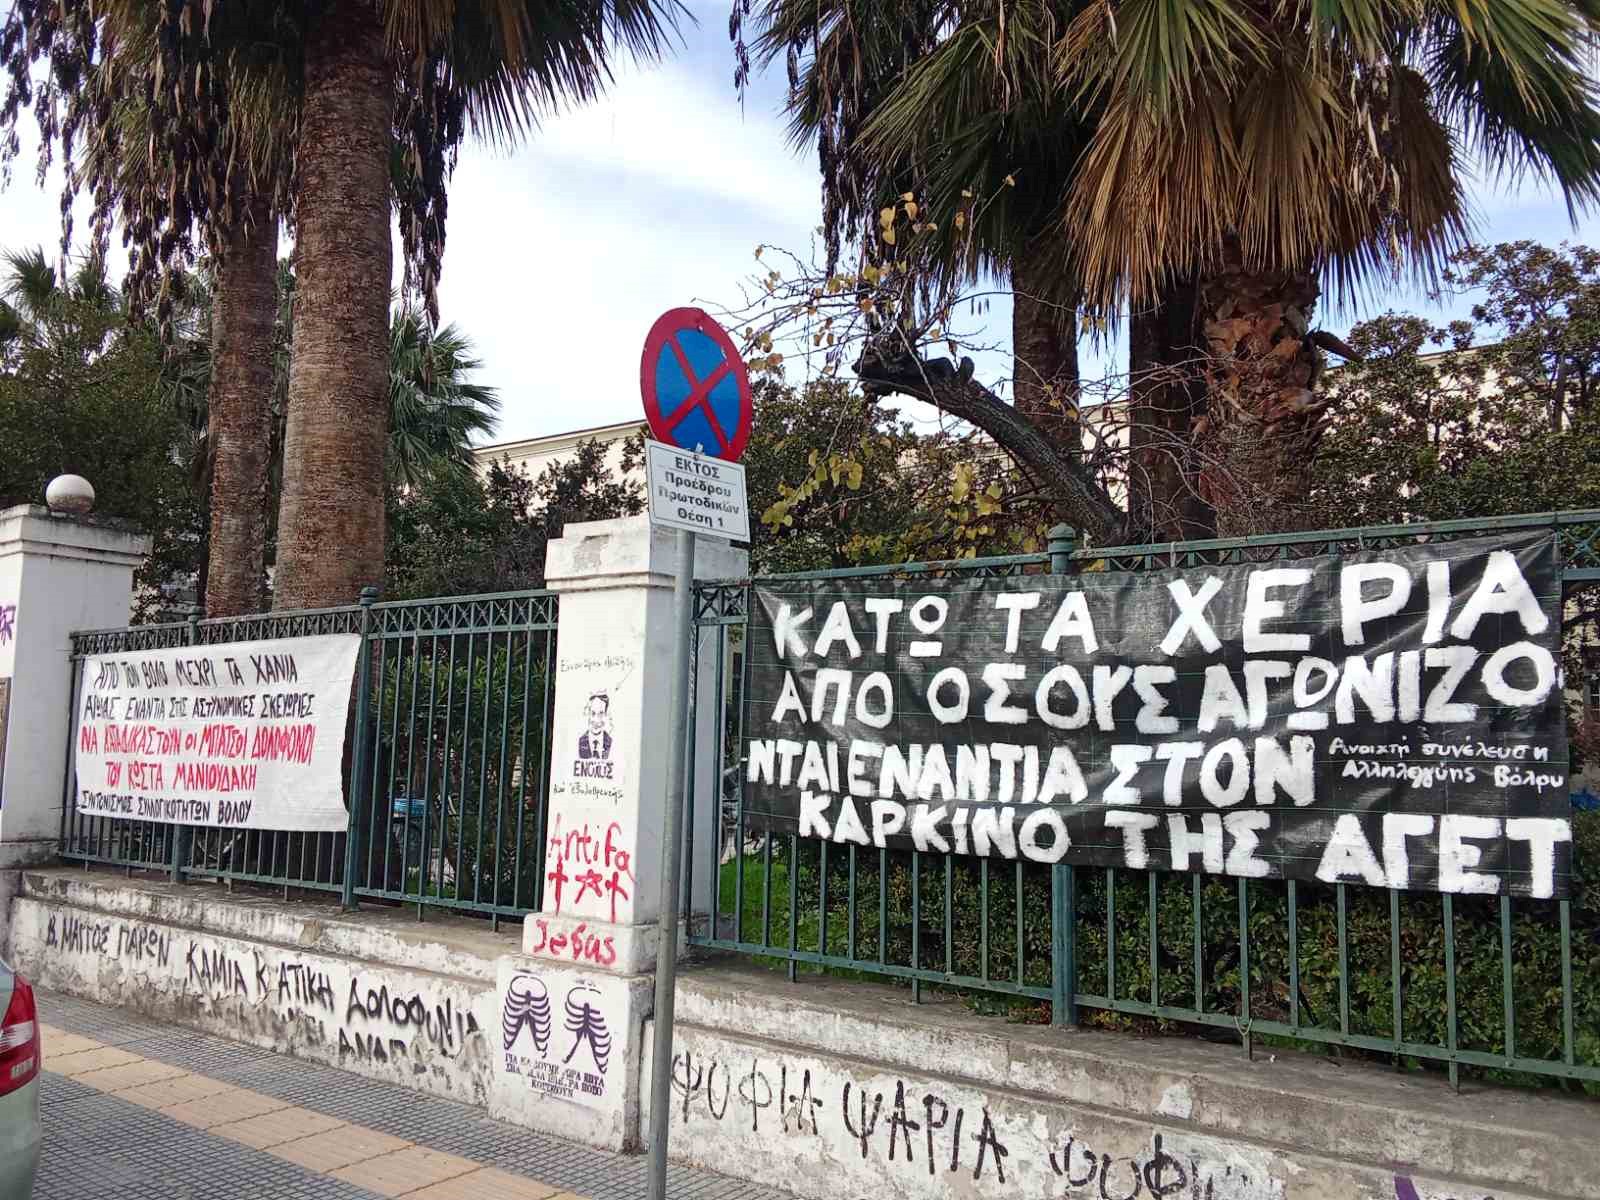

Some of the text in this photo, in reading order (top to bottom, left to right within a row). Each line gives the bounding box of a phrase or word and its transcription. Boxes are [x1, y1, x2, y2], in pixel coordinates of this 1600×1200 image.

[665, 471, 732, 497] Προέδρου
[675, 456, 720, 479] ΕΚΤΟΣ
[658, 485, 740, 514] Πρωτοδικών
[677, 507, 724, 527] Θέση 1
[773, 550, 1550, 659] ΚΑΤΩ ΤΑ ΧΕΡΙΑ
[93, 661, 119, 689] ΑΠΟ
[142, 660, 168, 689] ΒΟΛΟ
[175, 657, 218, 688] ΜΕΧΡΙ
[224, 657, 245, 685] ΤΑ
[250, 653, 298, 684] ΧΑΝΙΑ
[125, 697, 165, 720] ΕΝΑΝΤΙΑ
[192, 694, 256, 718] ΑΣΤΥΝΟΜΙΚΕΣ
[261, 692, 315, 718] ΣΚΕΥΩΡΙΕΣ
[771, 669, 894, 729] ΑΠΟ
[927, 662, 1179, 735] ΟΣΟΥΣ
[81, 726, 98, 755] ΝΑ
[199, 724, 248, 760] ΜΠΑΤΣΟΙ
[251, 723, 316, 766] ΔΟΛΟΦΟΝΟΙ
[105, 760, 257, 792] ΤΟΥ ΚΩΣΤΑ ΜΑΝΙΟΥΔΑΚΗ
[746, 735, 1316, 808] ΝΤΑΙ ΕΝΑΝΤΙΑ ΣΤΟΝ
[138, 796, 211, 822] ΣΥΛΛΟΓΙΚΟΤΗΤΩΝ
[218, 799, 252, 825] ΒΟΛΟΥ
[548, 812, 635, 878] Antifa
[799, 790, 1572, 900] ΚΑΡΚΙΝΟ ΤΗΣ ΑΓΕΤ
[117, 924, 171, 967] ΠΑΡΩΝ
[185, 940, 248, 998] ΚΑΜΙΑ
[253, 951, 335, 1014] ΚΑΤΙΚΗ
[842, 1079, 1009, 1184] ΨΑΡΙΑ
